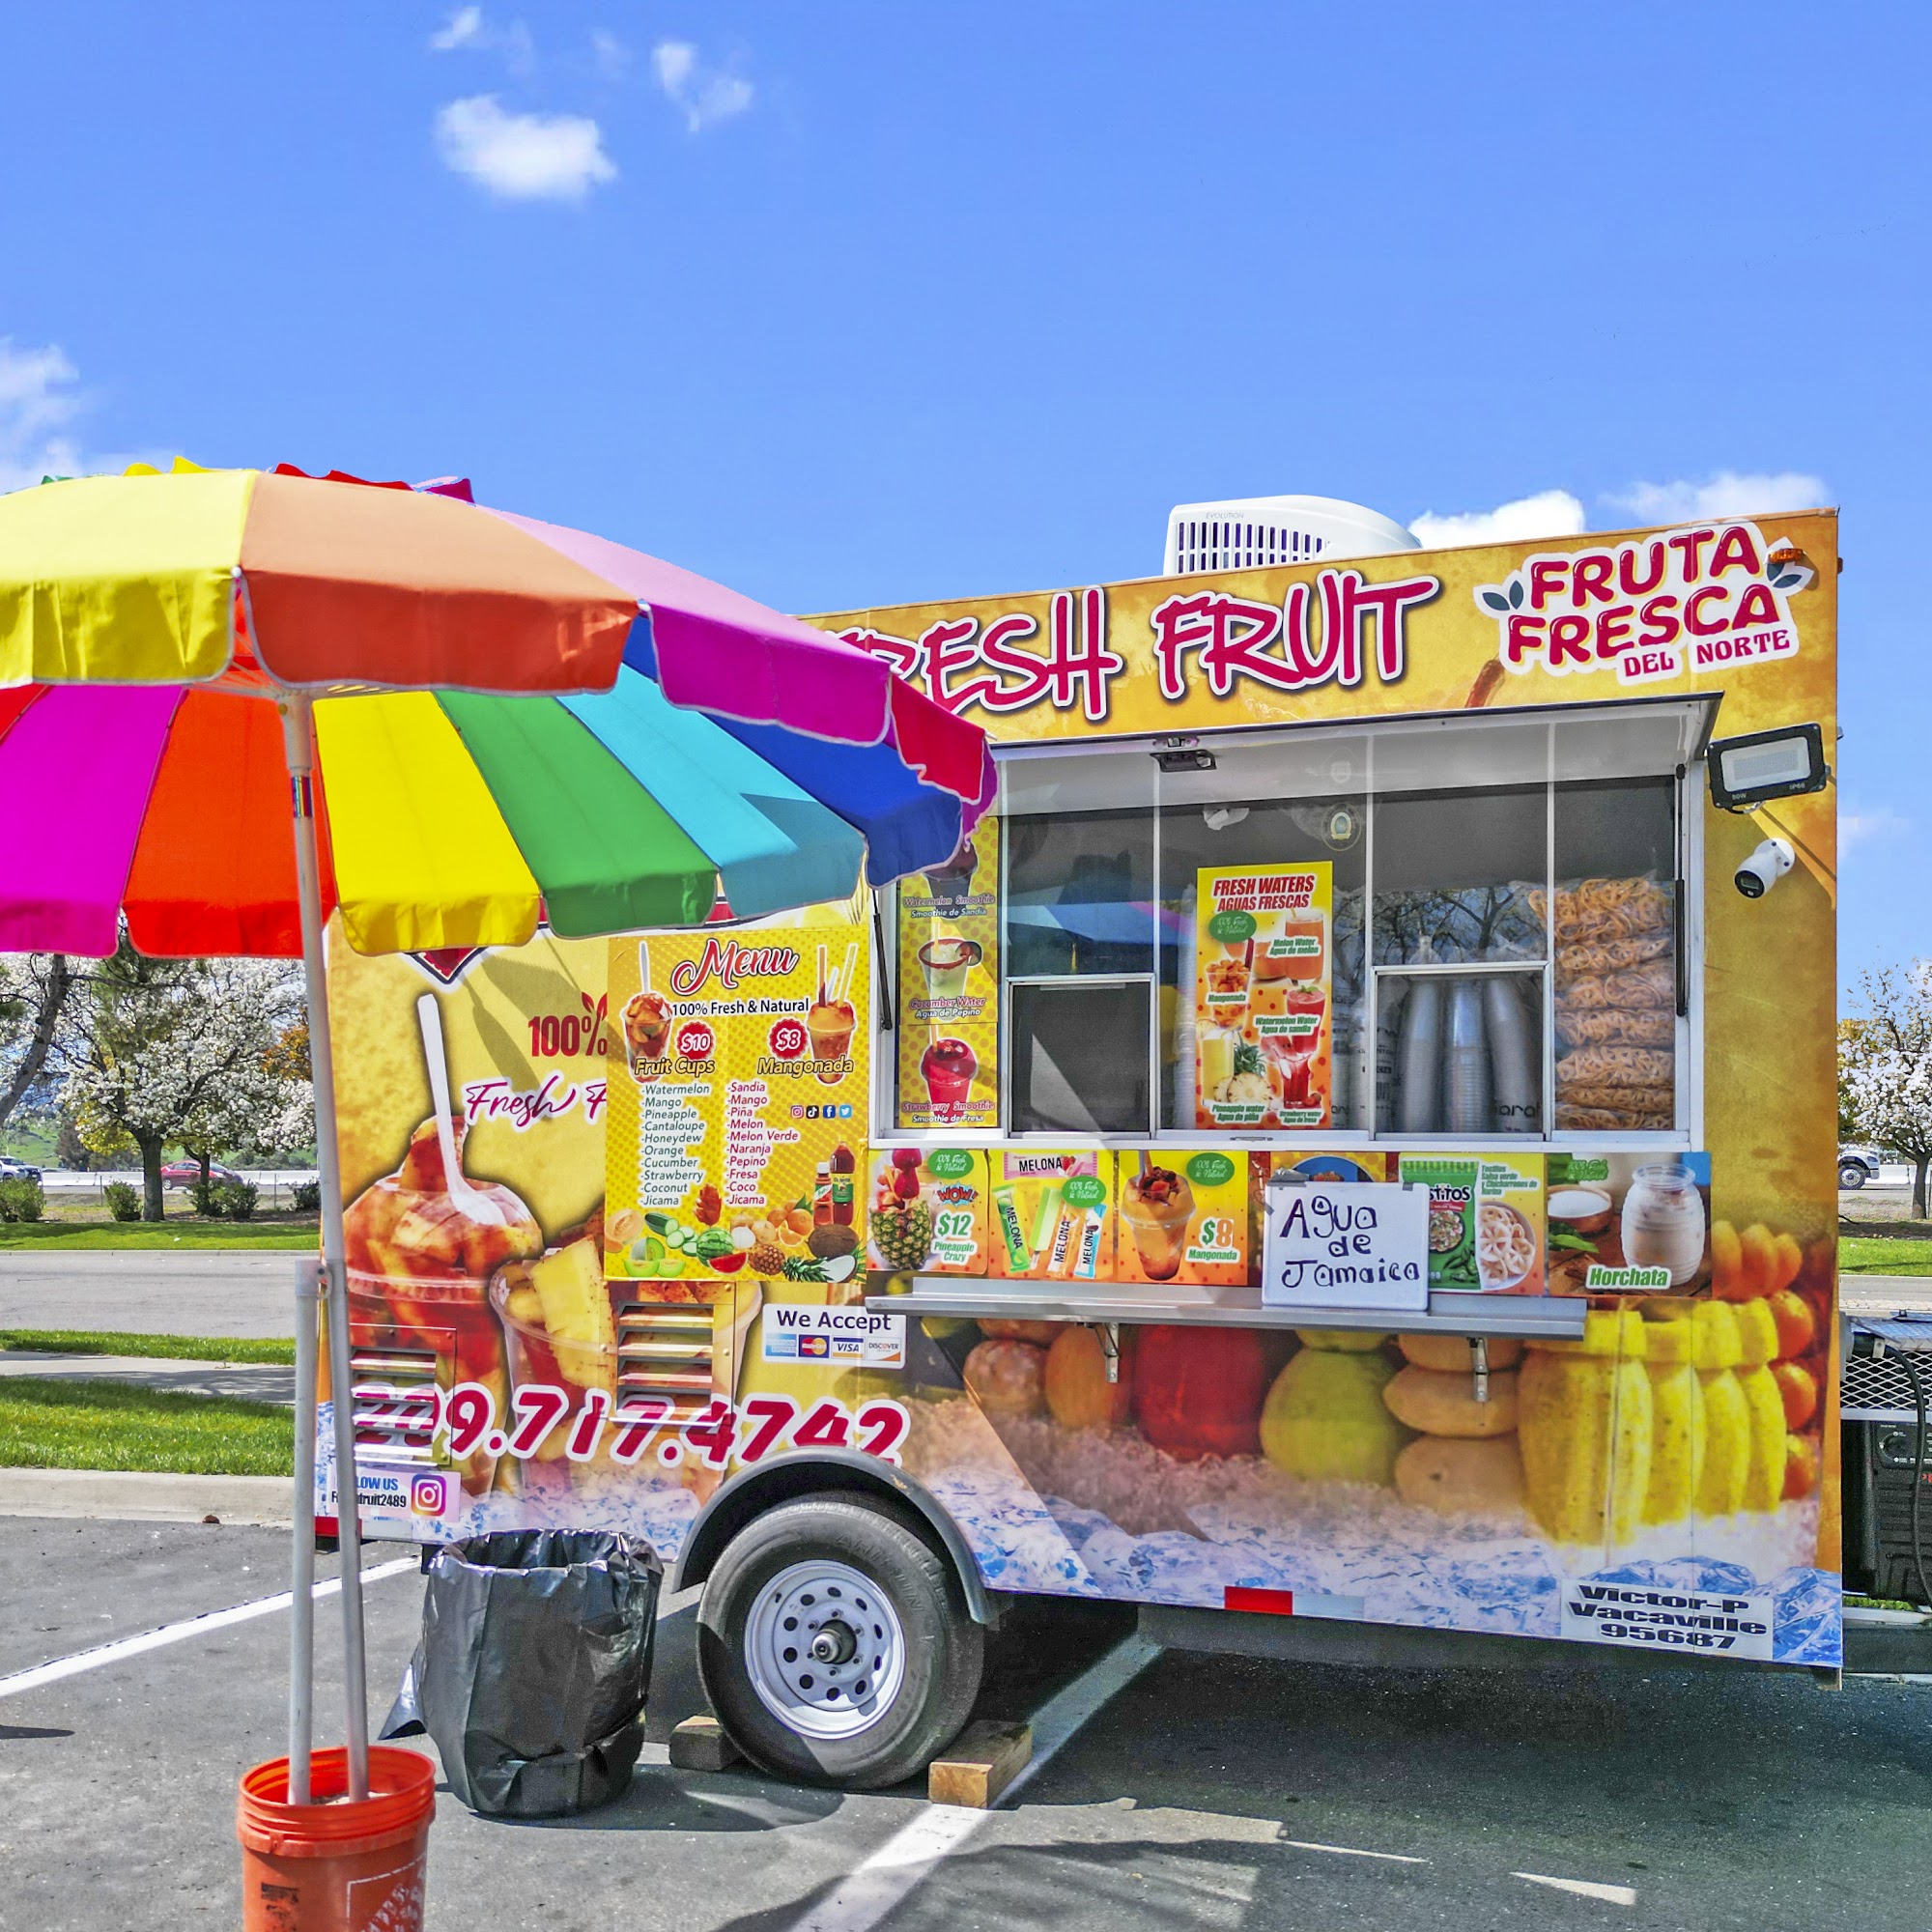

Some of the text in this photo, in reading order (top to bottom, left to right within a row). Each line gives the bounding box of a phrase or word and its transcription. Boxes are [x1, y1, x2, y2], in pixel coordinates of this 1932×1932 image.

[1531, 526, 1759, 609] FRUTA
[1508, 583, 1779, 666] FRESCA
[831, 572, 1436, 717] ESH FRUIT
[1624, 630, 1790, 678] DEL NORTE
[1213, 875, 1316, 896] FRESH WATERS
[903, 894, 996, 908] Watermelon Smoothie
[1217, 894, 1310, 912] AGUAS FRESCAS
[1294, 937, 1316, 947] Water
[670, 938, 800, 996] Menu
[673, 997, 810, 1016] 100% Fresh & Natural
[910, 996, 986, 1009] Cucumber Water
[916, 1009, 981, 1019] Agua de Pepino
[527, 1013, 607, 1057] 100%
[680, 1031, 711, 1053] $10
[777, 1029, 802, 1051] $8
[634, 1056, 715, 1079] Fruit Cups
[757, 1055, 854, 1079] Mangonada
[641, 1084, 710, 1095] -Watermelon
[727, 1082, 766, 1094] -Sandia
[466, 1075, 577, 1127] Fresh
[641, 1097, 682, 1111] -Mango
[727, 1094, 769, 1107] -Mango
[902, 1099, 995, 1113] Strawberry Smoothie
[641, 1109, 697, 1121] -Pineapple
[726, 1107, 753, 1118] -Piña
[641, 1122, 705, 1134] -Cantaloupe
[726, 1119, 763, 1130] -Melon
[641, 1133, 703, 1146] -Honeydew
[726, 1130, 799, 1142] -Melon Verde
[640, 1146, 684, 1157] -Orange
[726, 1144, 771, 1155] -Naranja
[640, 1157, 698, 1169] -Cucumber
[726, 1156, 767, 1168] -Pepino
[1019, 1156, 1063, 1173] MELONA
[639, 1171, 703, 1183] -Strawberry
[726, 1169, 758, 1179] -Fresa
[639, 1182, 688, 1194] -Coconut
[726, 1182, 756, 1192] -Coco
[639, 1196, 680, 1207] -Jicama
[725, 1194, 765, 1206] -Jicama
[937, 1186, 979, 1203] WOW!
[1279, 1195, 1378, 1238] Agua
[937, 1212, 972, 1236] $12
[1006, 1207, 1024, 1250] MELONA
[1202, 1219, 1235, 1248] $8
[933, 1241, 975, 1252] Pineapple
[1053, 1220, 1071, 1264] MELONA
[1082, 1229, 1095, 1265] MELONA
[1328, 1234, 1372, 1258] de
[943, 1252, 966, 1263] Crazy
[1188, 1250, 1237, 1261] Mangonada
[1281, 1258, 1420, 1289] Jamaica
[1589, 1267, 1668, 1287] Horchata
[777, 1310, 892, 1333] We Accept
[838, 1343, 860, 1352] VISA
[383, 1478, 398, 1491] US
[1577, 1584, 1749, 1613] Victor-P
[1567, 1602, 1768, 1634] Vacaville
[1600, 1623, 1737, 1650] 95687
